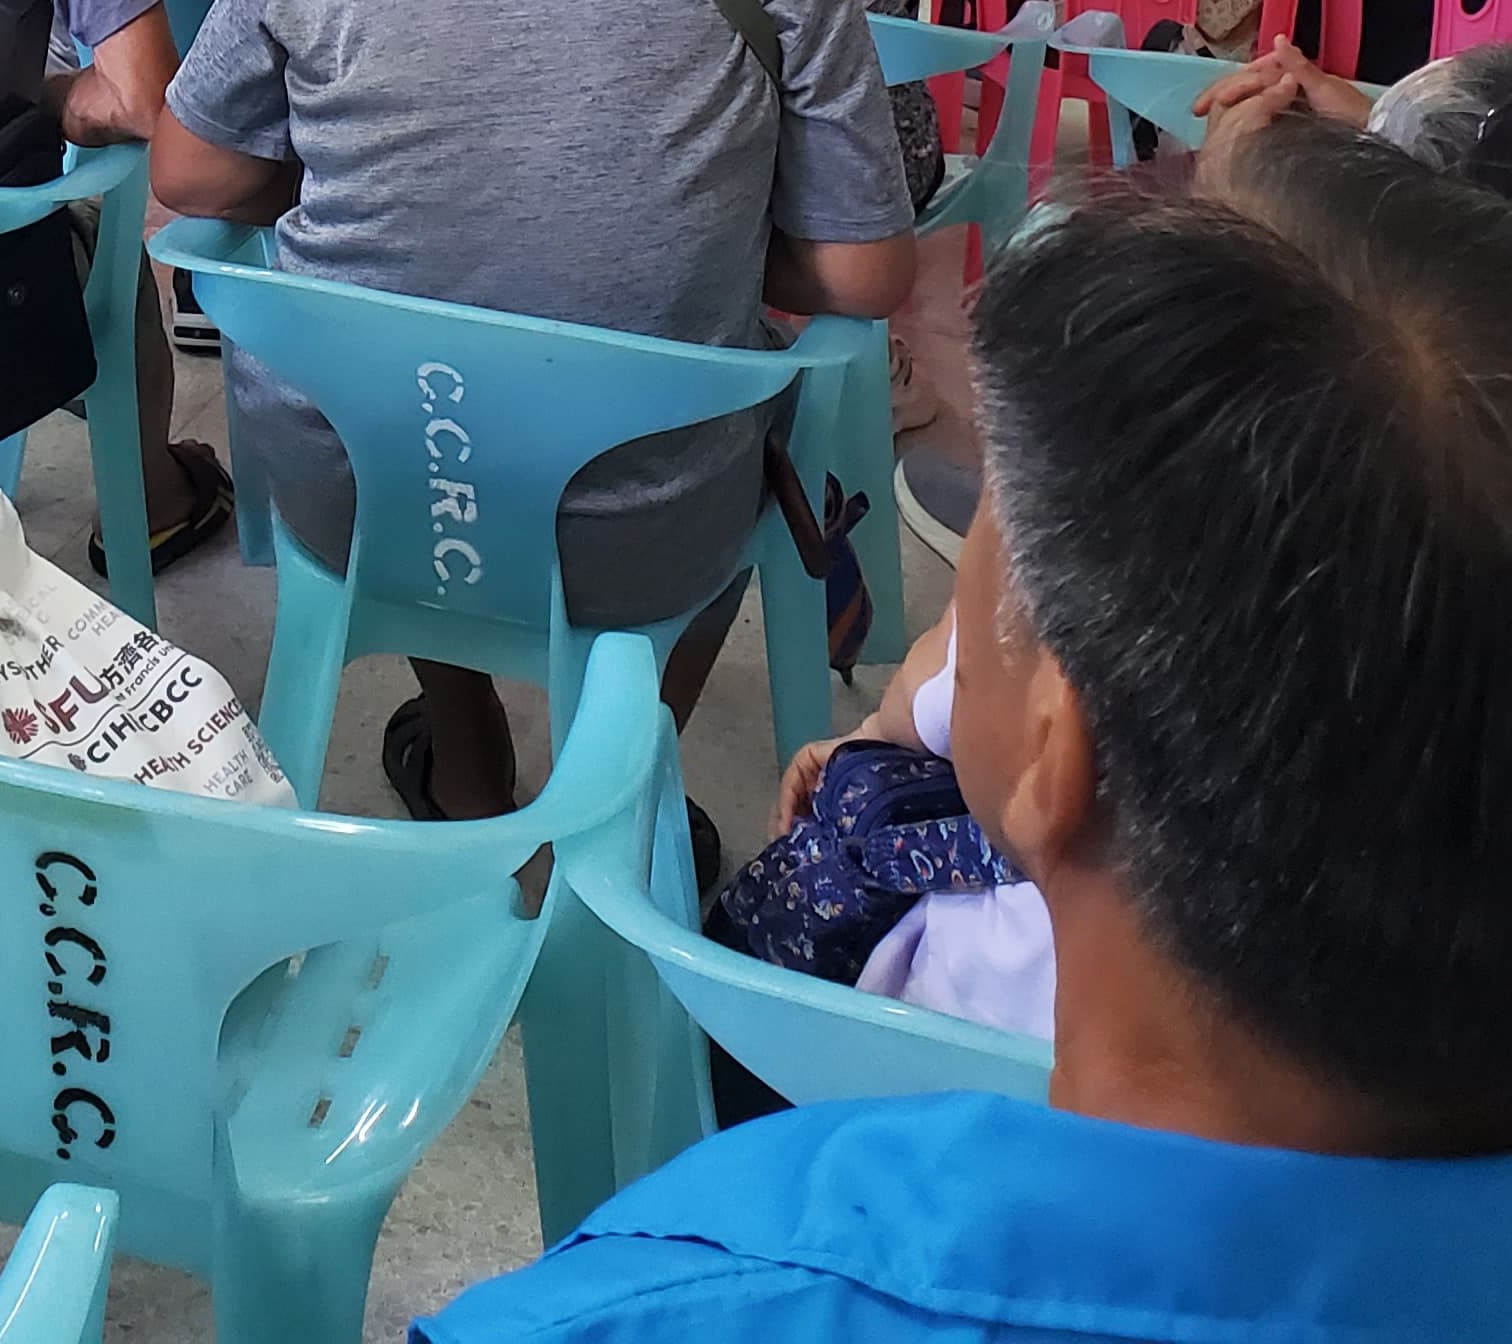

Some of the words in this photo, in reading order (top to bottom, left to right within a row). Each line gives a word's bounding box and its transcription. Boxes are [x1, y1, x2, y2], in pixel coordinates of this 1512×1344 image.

[417, 362, 482, 596] C.C.R.C.
[203, 749, 250, 793] HEALTH
[225, 769, 254, 797] CARE
[36, 851, 116, 1160] C.C.R.C.
